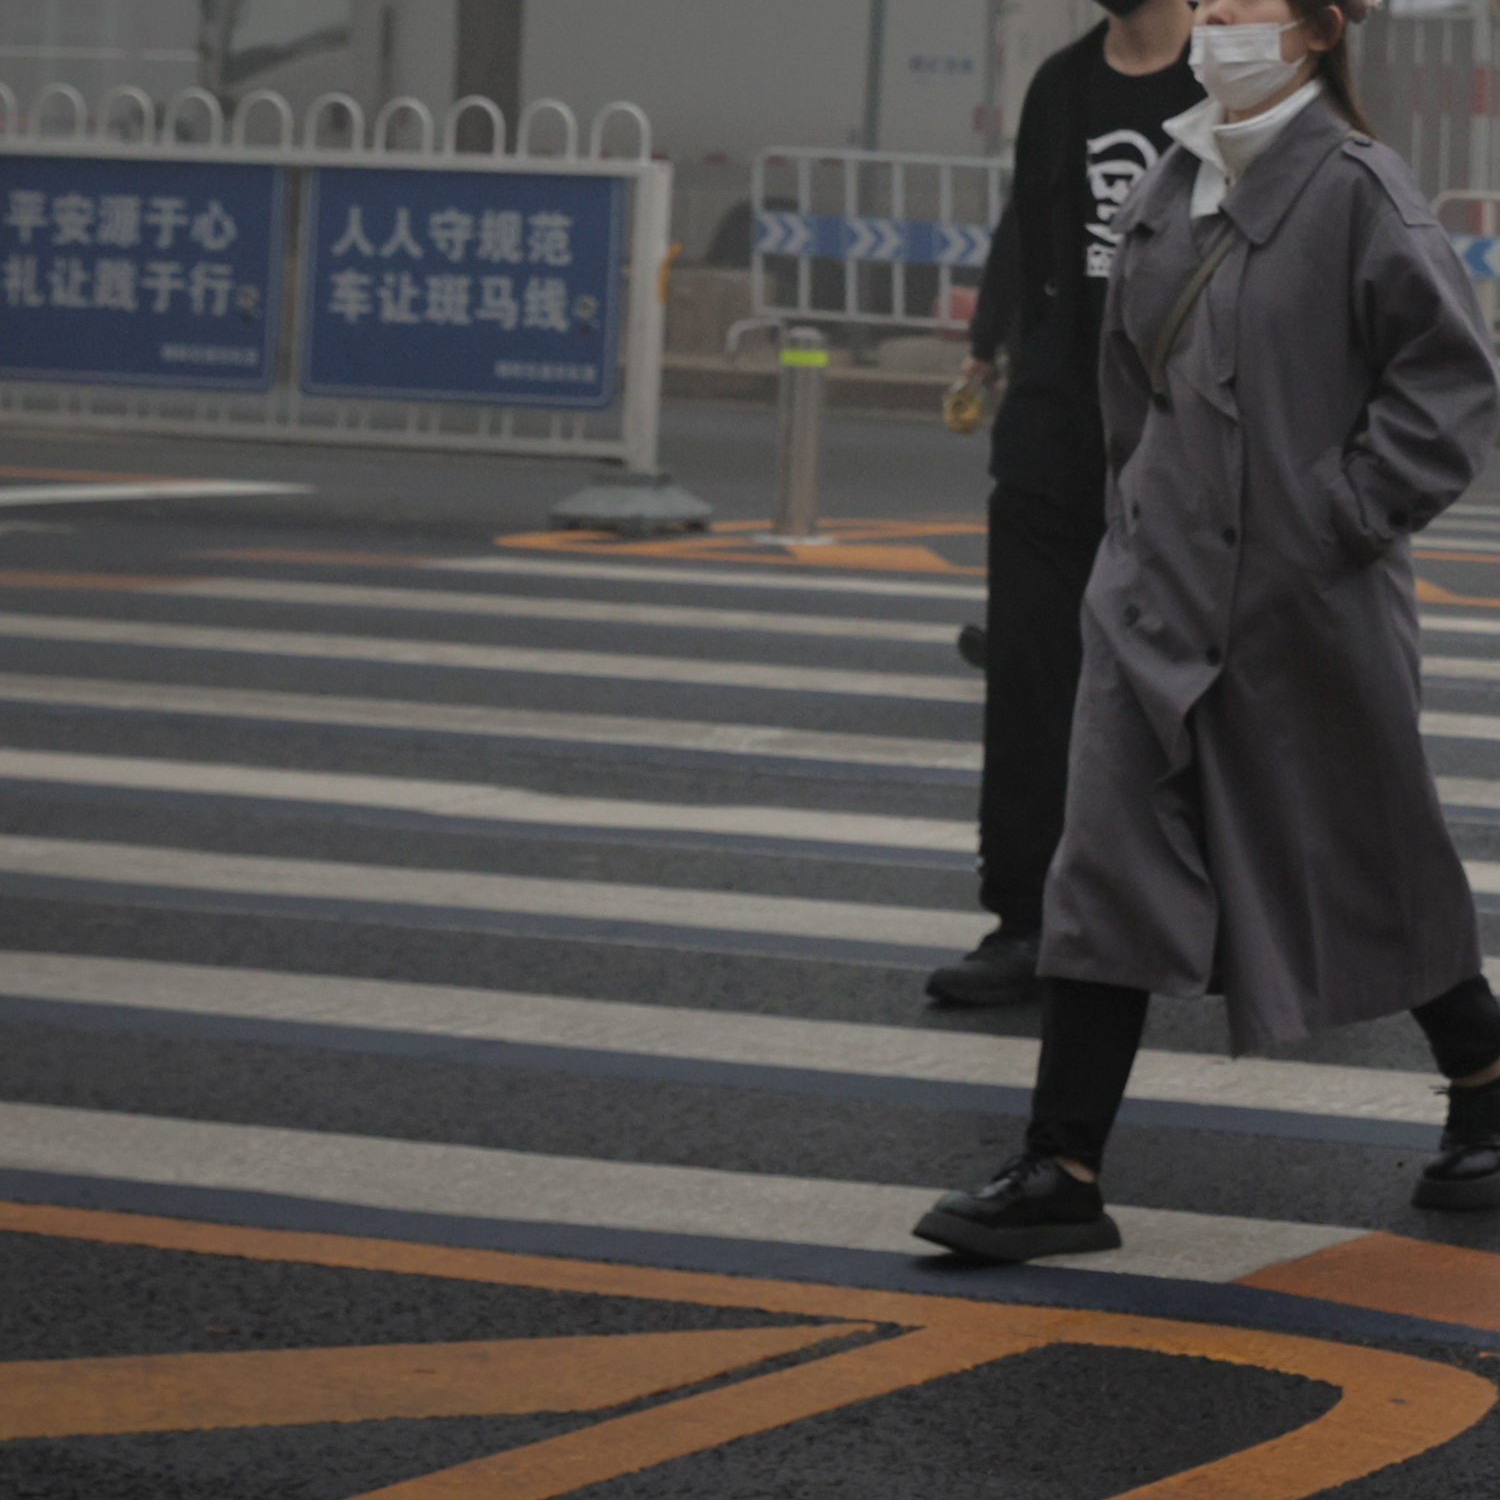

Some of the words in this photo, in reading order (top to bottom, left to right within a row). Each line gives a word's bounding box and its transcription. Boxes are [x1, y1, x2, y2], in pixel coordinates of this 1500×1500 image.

[3, 189, 239, 251] 平安源于心
[330, 203, 576, 267] 人人守规范
[0, 252, 235, 316] 礼让践于行
[328, 268, 571, 333] 车让斑马线
